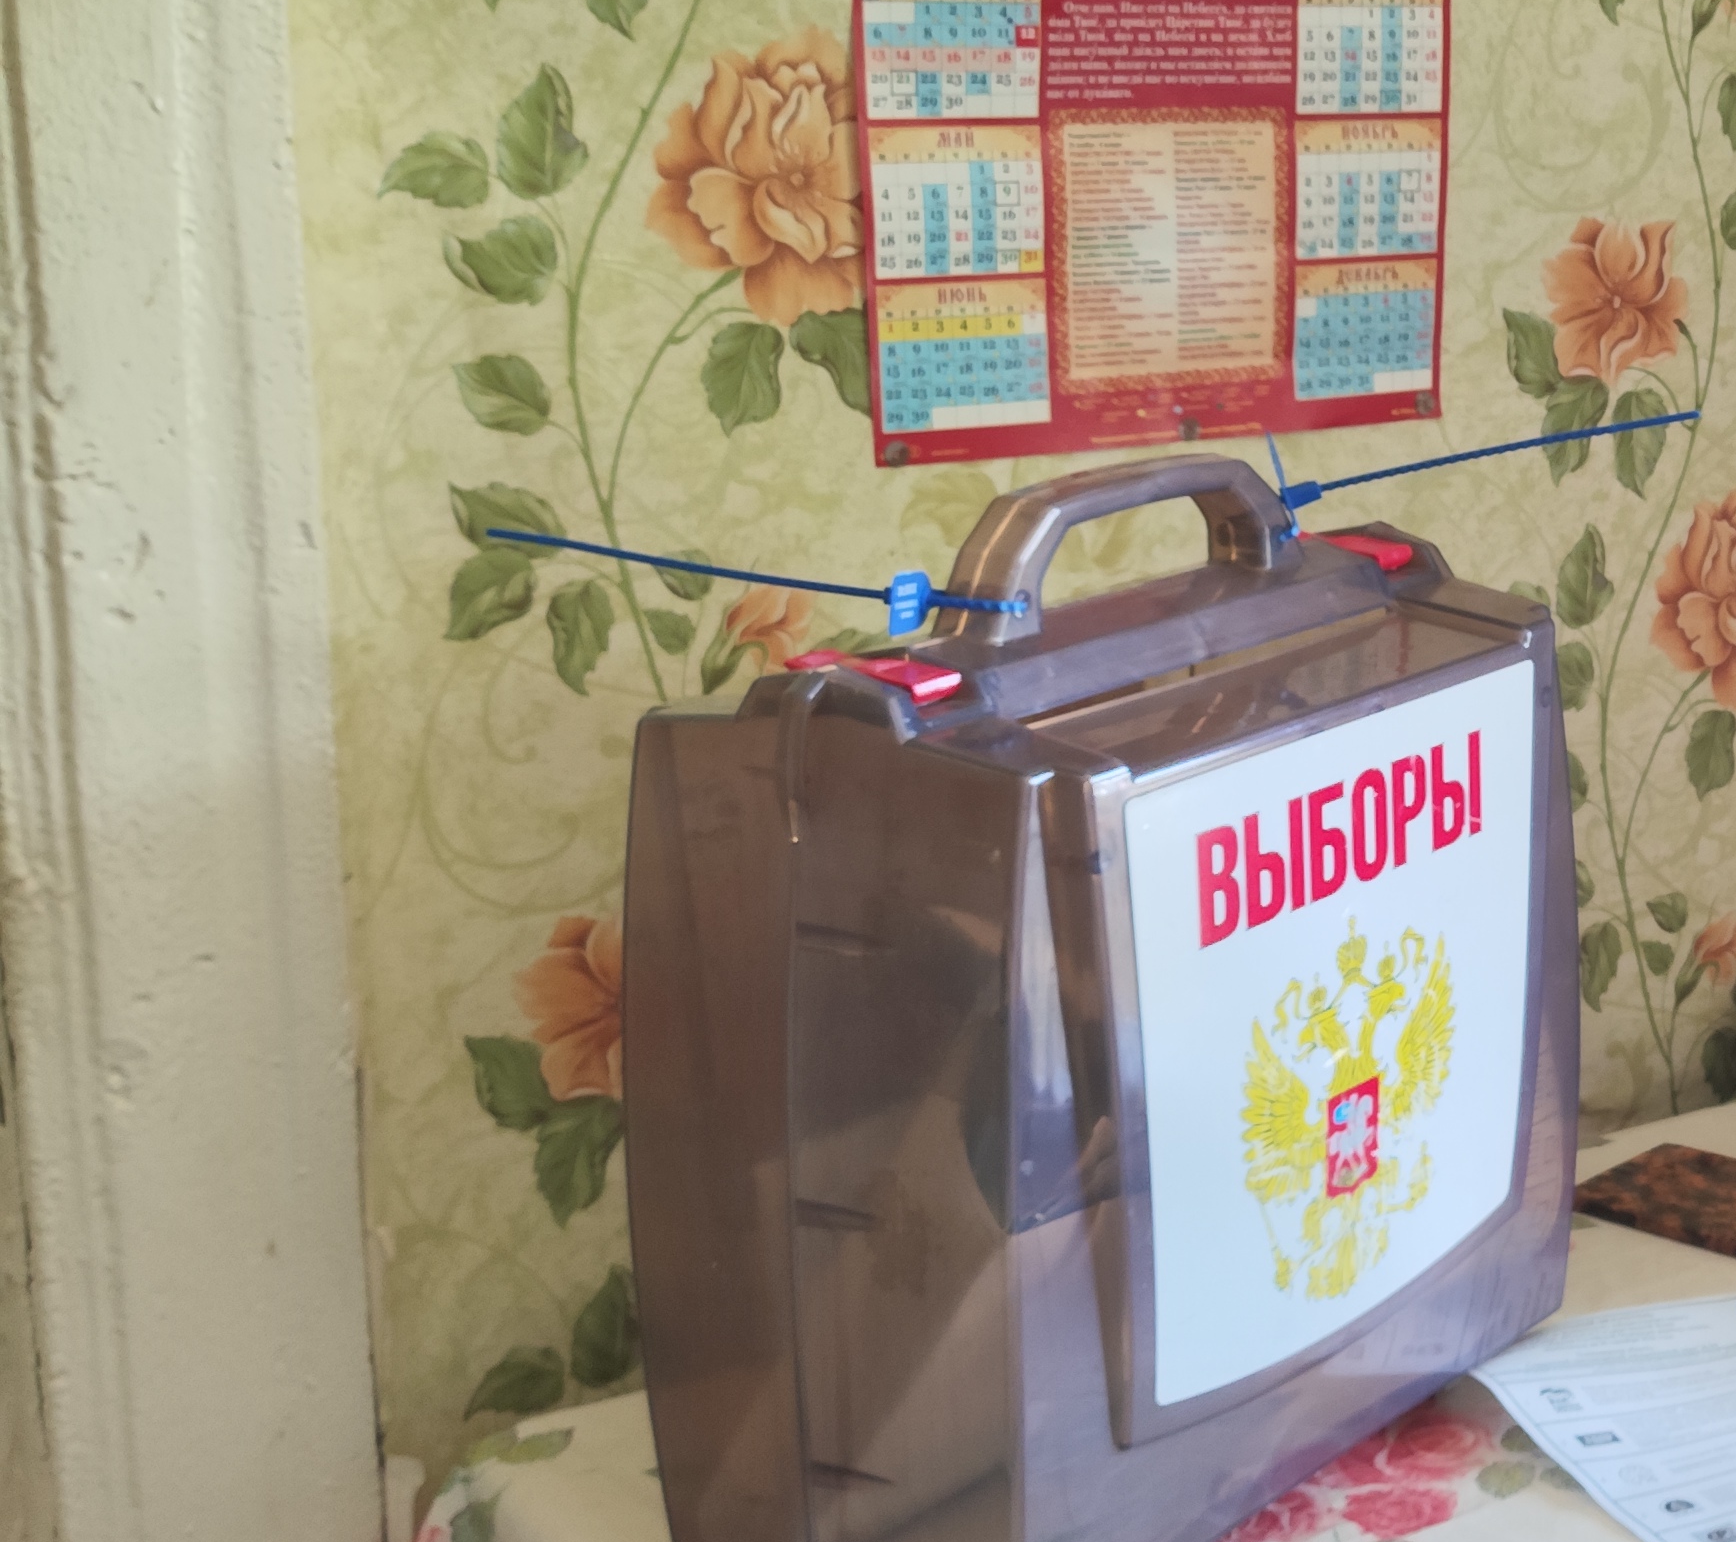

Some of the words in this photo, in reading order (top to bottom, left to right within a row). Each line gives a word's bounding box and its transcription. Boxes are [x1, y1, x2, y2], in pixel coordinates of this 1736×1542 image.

[925, 5, 930, 14] 1
[975, 6, 982, 18] 3
[999, 7, 1007, 18] 4
[873, 28, 882, 39] 6
[924, 28, 932, 39] 8
[949, 28, 957, 39] 9
[972, 28, 986, 38] 10
[998, 28, 1009, 38] 11
[872, 51, 886, 61] 13
[897, 51, 910, 61] 14
[922, 51, 935, 62] 15
[948, 52, 961, 63] 16
[972, 51, 985, 60] 17
[998, 52, 1011, 63] 18
[1022, 51, 1035, 61] 19
[871, 74, 888, 84] 20
[897, 74, 910, 84] 21
[921, 74, 937, 84] 22
[947, 75, 962, 86] 23
[971, 74, 986, 85] 24
[996, 75, 1011, 86] 25
[873, 96, 888, 107] 27
[896, 98, 912, 110] 28
[921, 97, 938, 107] 29
[946, 97, 963, 109] 30
[980, 165, 985, 174] 1
[1003, 164, 1009, 173] 2
[881, 189, 889, 200] 4
[908, 188, 915, 200] 5
[932, 188, 940, 199] 6
[957, 186, 963, 198] 7
[980, 187, 988, 197] 8
[1003, 186, 1011, 196] 9
[881, 212, 892, 221] 11
[906, 211, 919, 220] 12
[931, 211, 944, 222] 13
[955, 210, 968, 220] 14
[979, 209, 991, 220] 15
[1003, 211, 1015, 220] 16
[881, 235, 895, 247] 18
[908, 234, 921, 244] 19
[929, 233, 946, 242] 20
[956, 232, 968, 241] 21
[978, 231, 993, 241] 22
[1002, 231, 1017, 241] 23
[1025, 230, 1039, 239] 24
[881, 257, 896, 269] 25
[906, 259, 922, 269] 26
[931, 254, 945, 266] 27
[954, 255, 970, 266] 28
[977, 253, 993, 263] 29
[1001, 253, 1017, 264] 30
[1025, 252, 1037, 263] 31
[938, 287, 986, 304] ИЮНЬ
[888, 324, 893, 332] 1
[912, 322, 919, 331] 2
[937, 321, 944, 332] 3
[960, 320, 967, 331] 4
[985, 319, 992, 330] 5
[1008, 319, 1015, 329] 6
[888, 346, 896, 356] 8
[913, 344, 921, 354] 9
[934, 343, 948, 352] 10
[959, 342, 970, 351] 11
[983, 341, 996, 349] 12
[1006, 339, 1019, 350] 13
[887, 366, 900, 378] 15
[912, 366, 925, 377] 16
[936, 363, 948, 373] 17
[960, 364, 973, 374] 18
[984, 362, 997, 372] 19
[1005, 360, 1022, 370] 20
[886, 390, 901, 400] 22
[936, 388, 951, 397] 24
[959, 386, 974, 397] 25
[984, 386, 999, 396] 26
[887, 413, 903, 423] 29
[912, 412, 929, 423] 30
[1194, 730, 1483, 949] ВЫБОРЫ
